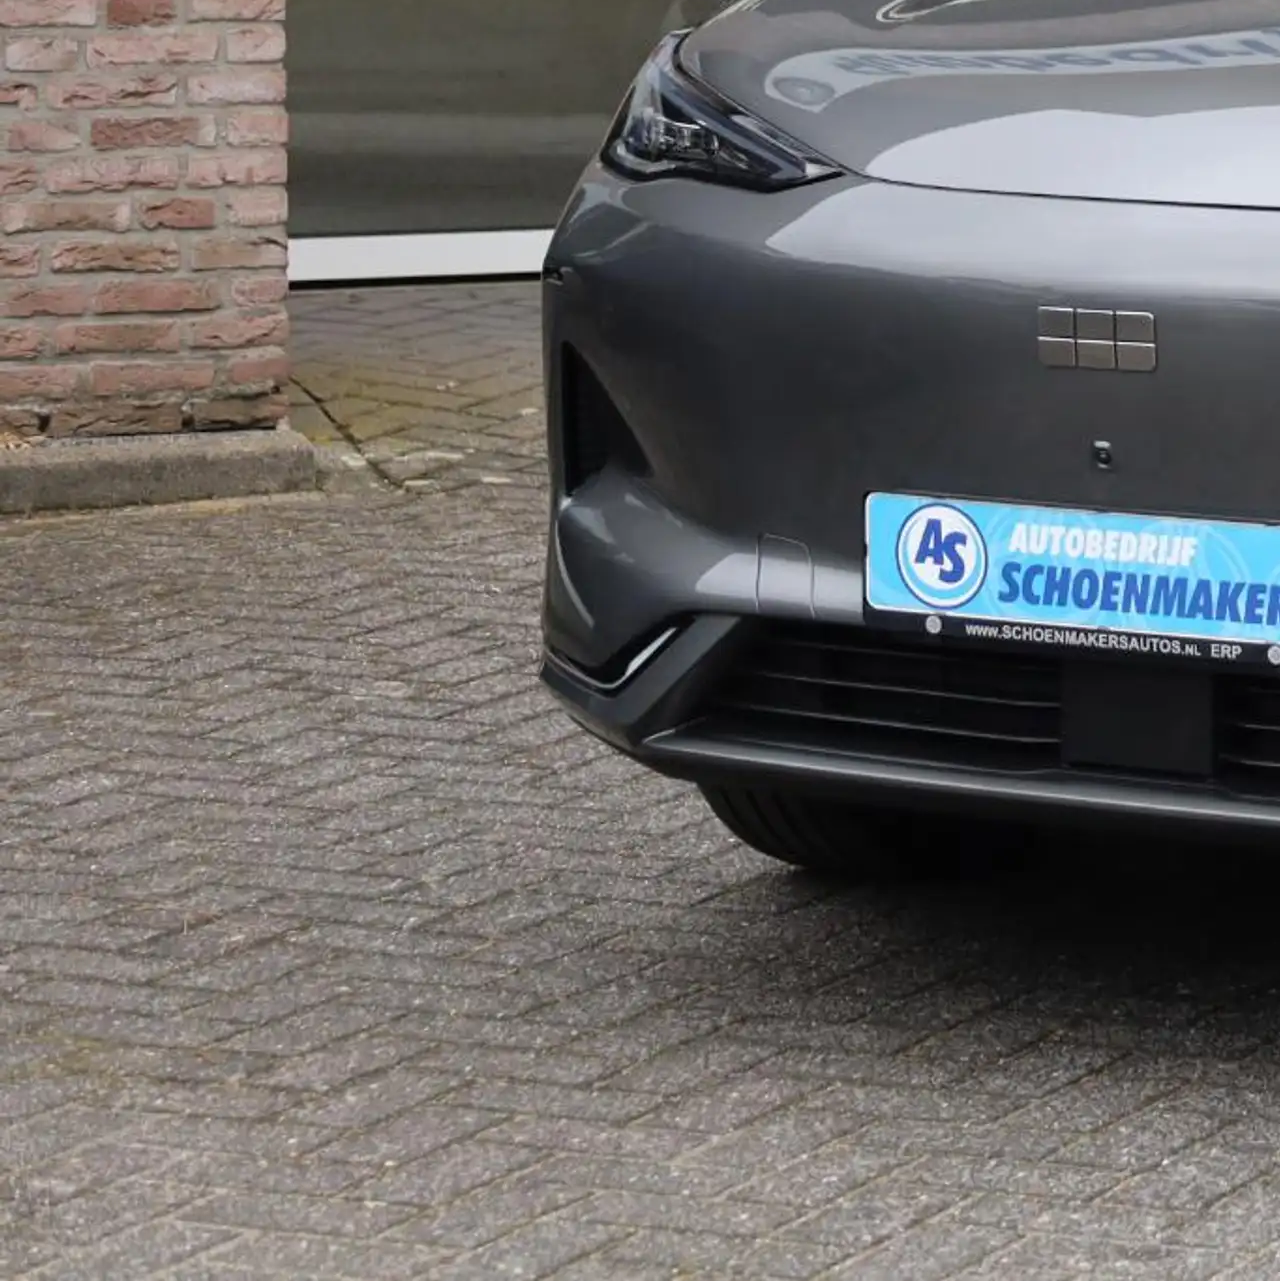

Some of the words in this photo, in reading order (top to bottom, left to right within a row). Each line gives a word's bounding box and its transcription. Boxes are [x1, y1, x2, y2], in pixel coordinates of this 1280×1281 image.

[914, 518, 967, 584] AS
[1008, 523, 1198, 566] AUTOBEDRIJF
[1210, 643, 1242, 659] ERP
